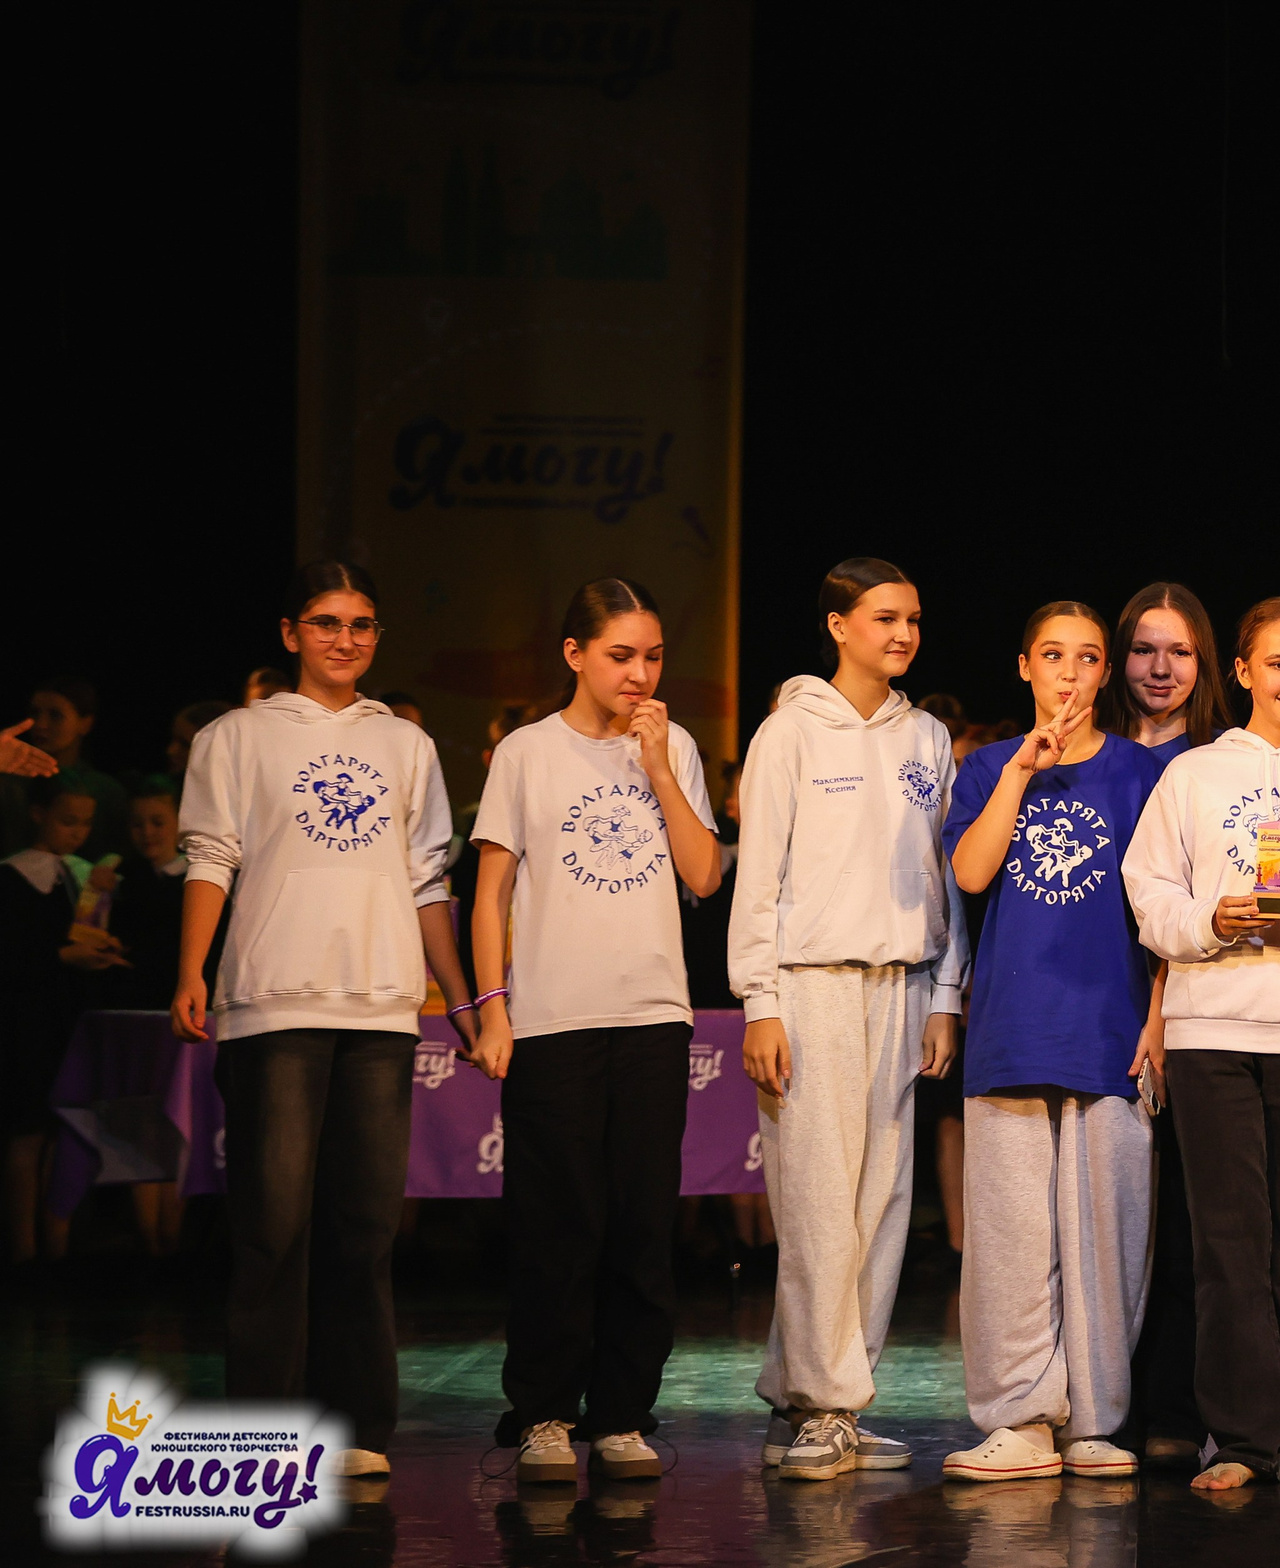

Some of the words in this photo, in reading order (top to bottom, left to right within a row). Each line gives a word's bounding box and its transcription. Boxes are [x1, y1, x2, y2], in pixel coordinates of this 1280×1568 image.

[389, 413, 465, 511] Я
[461, 431, 674, 524] могу!
[293, 753, 390, 794] ВОЛГАРЯТА
[825, 784, 857, 795] Ксения
[561, 784, 667, 834] ВОЛГАРЯТА
